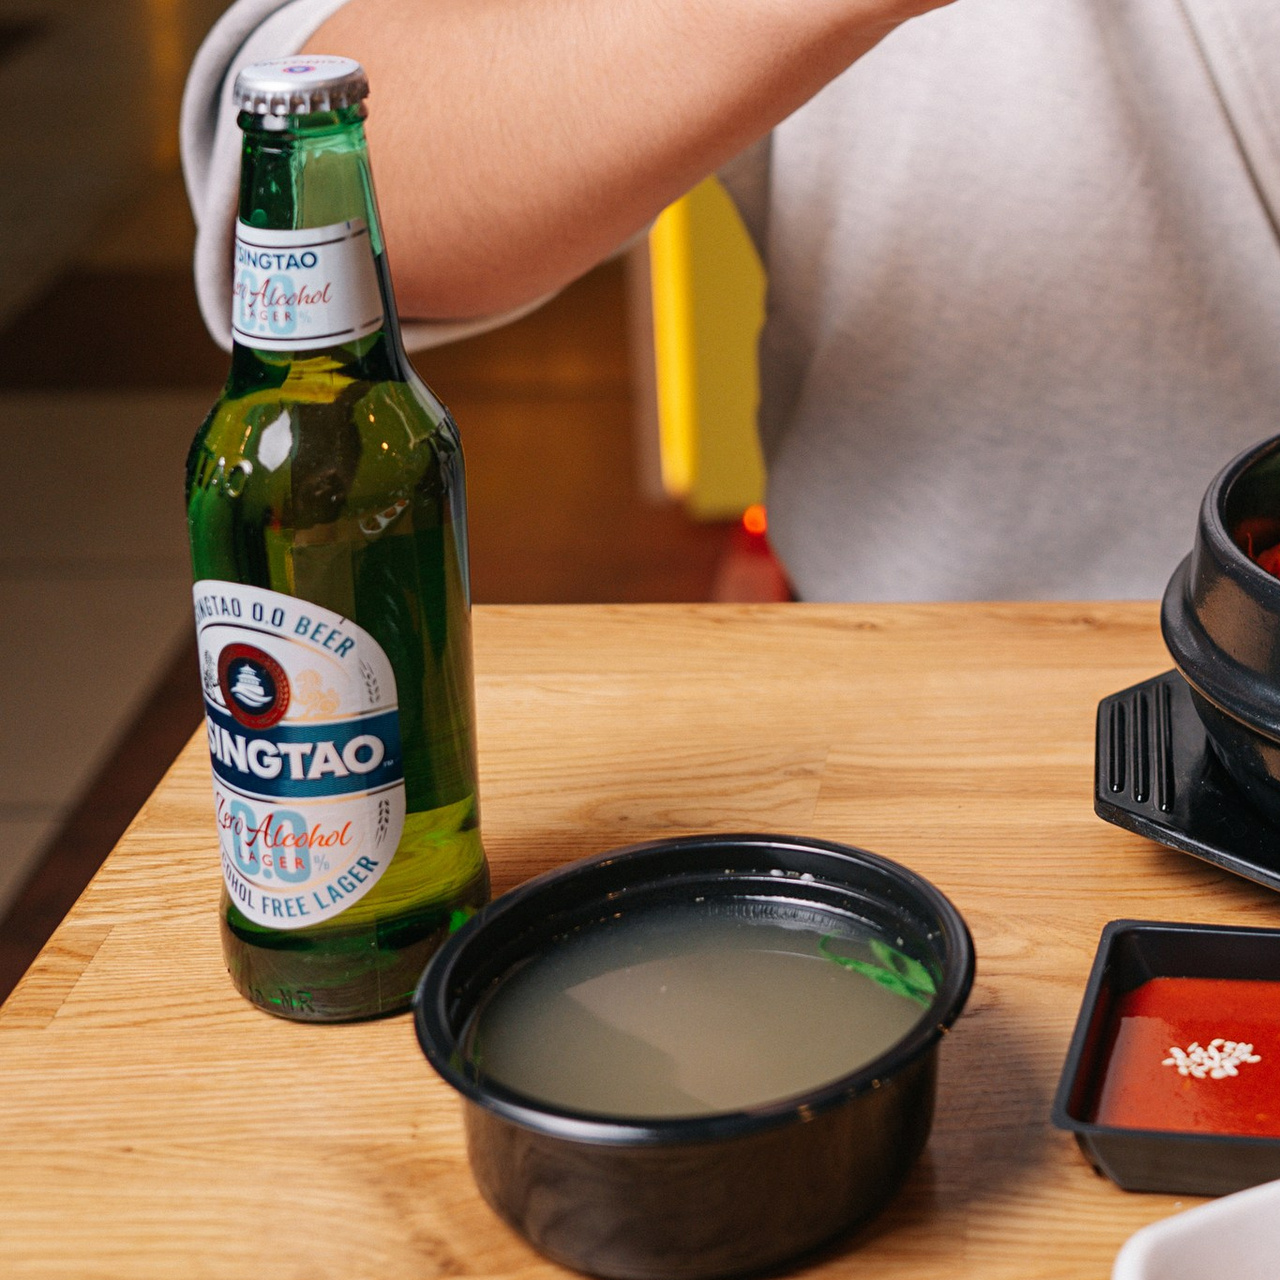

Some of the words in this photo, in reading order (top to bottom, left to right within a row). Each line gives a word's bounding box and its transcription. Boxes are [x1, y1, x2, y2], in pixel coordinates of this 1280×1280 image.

[248, 278, 333, 309] Alcohol
[195, 595, 242, 625] SINGTAO
[252, 602, 285, 627] 0.0
[294, 615, 356, 658] BEER
[206, 714, 386, 781] SINGTAO
[216, 791, 244, 836] Zero
[245, 813, 354, 849] Alcohol
[238, 846, 306, 871] LAGER
[262, 895, 311, 918] FREE
[313, 855, 380, 910] LAGER
